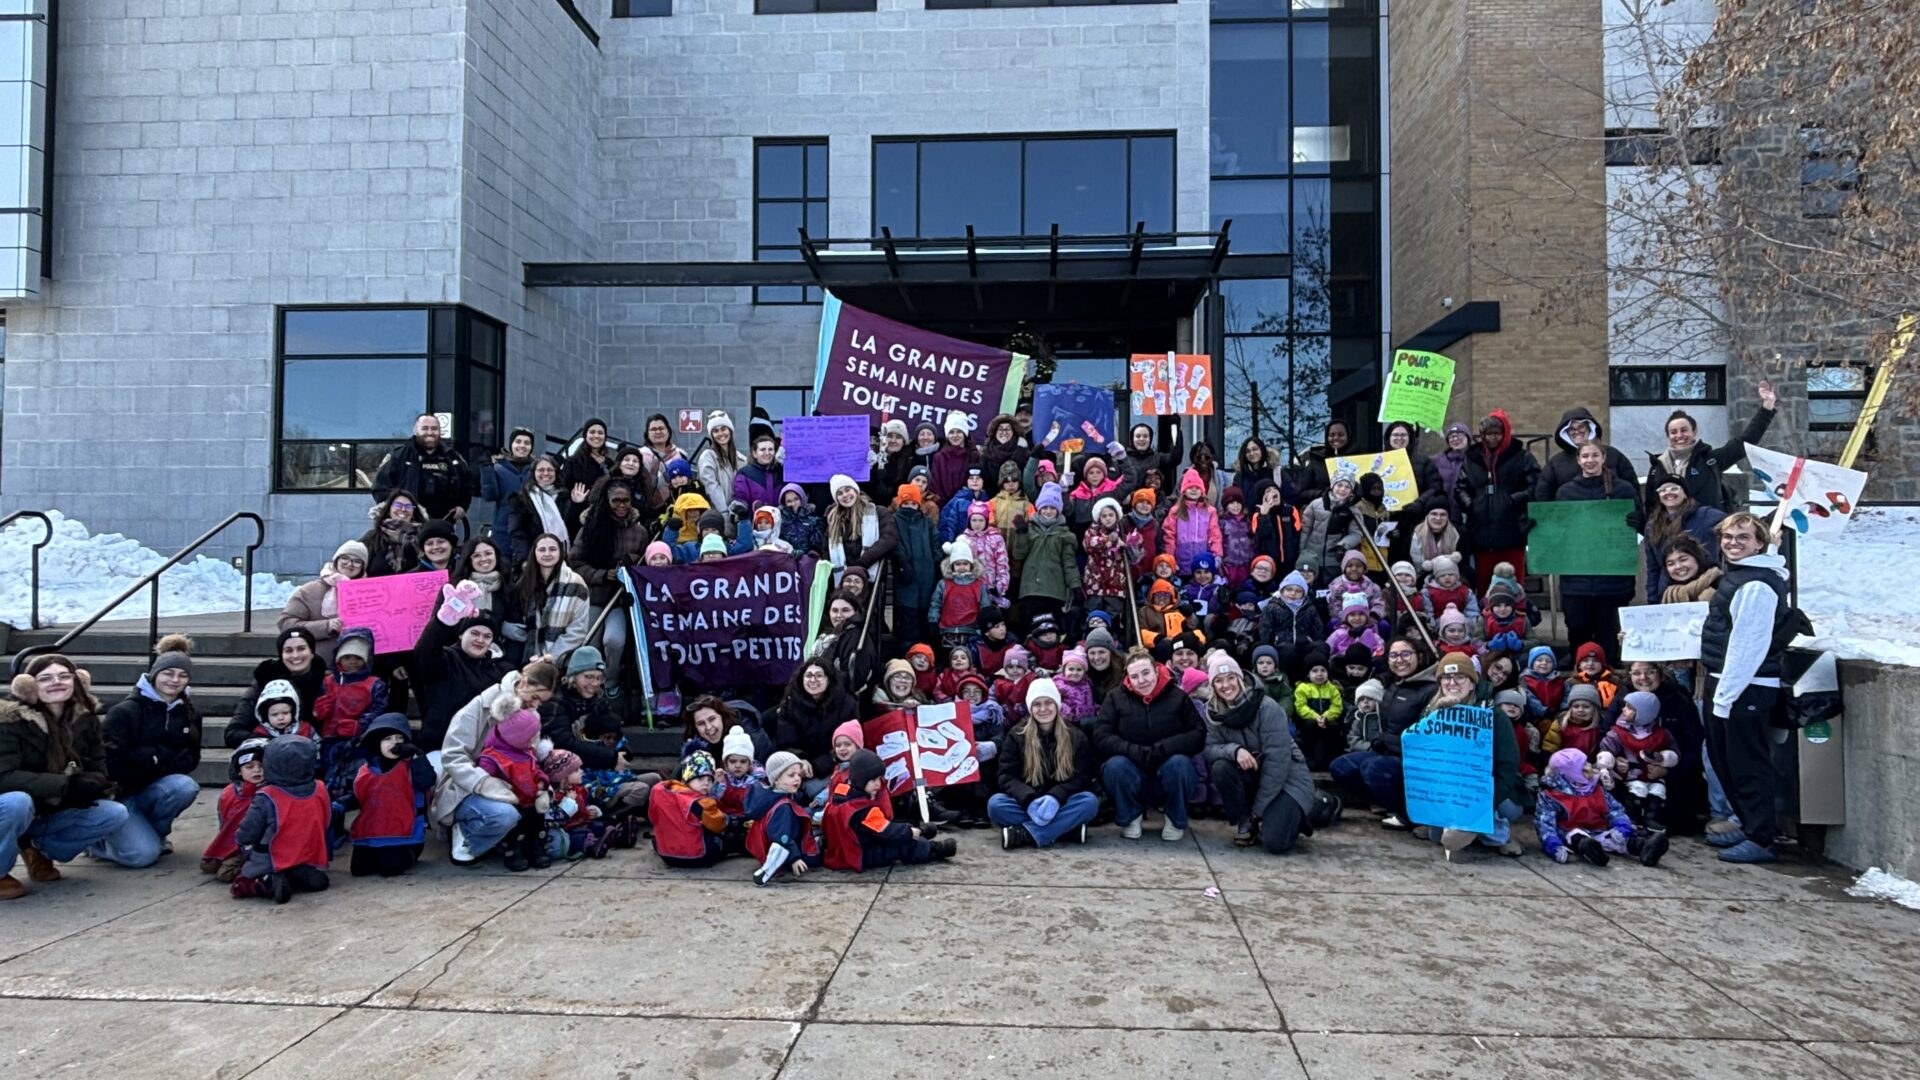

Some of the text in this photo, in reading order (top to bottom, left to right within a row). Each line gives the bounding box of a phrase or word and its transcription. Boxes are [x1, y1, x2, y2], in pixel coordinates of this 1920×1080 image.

[850, 329, 990, 382] LA GRANDE
[1397, 352, 1431, 369] POUR
[845, 356, 983, 405] SEMAINE DES
[1405, 374, 1446, 392] SOMMET
[842, 381, 978, 431] TOUT-PETS
[645, 582, 675, 604] LA
[650, 608, 753, 631] SEMAINE
[654, 636, 802, 665] TOUT-PETITS
[1423, 720, 1480, 741] SOMMET
